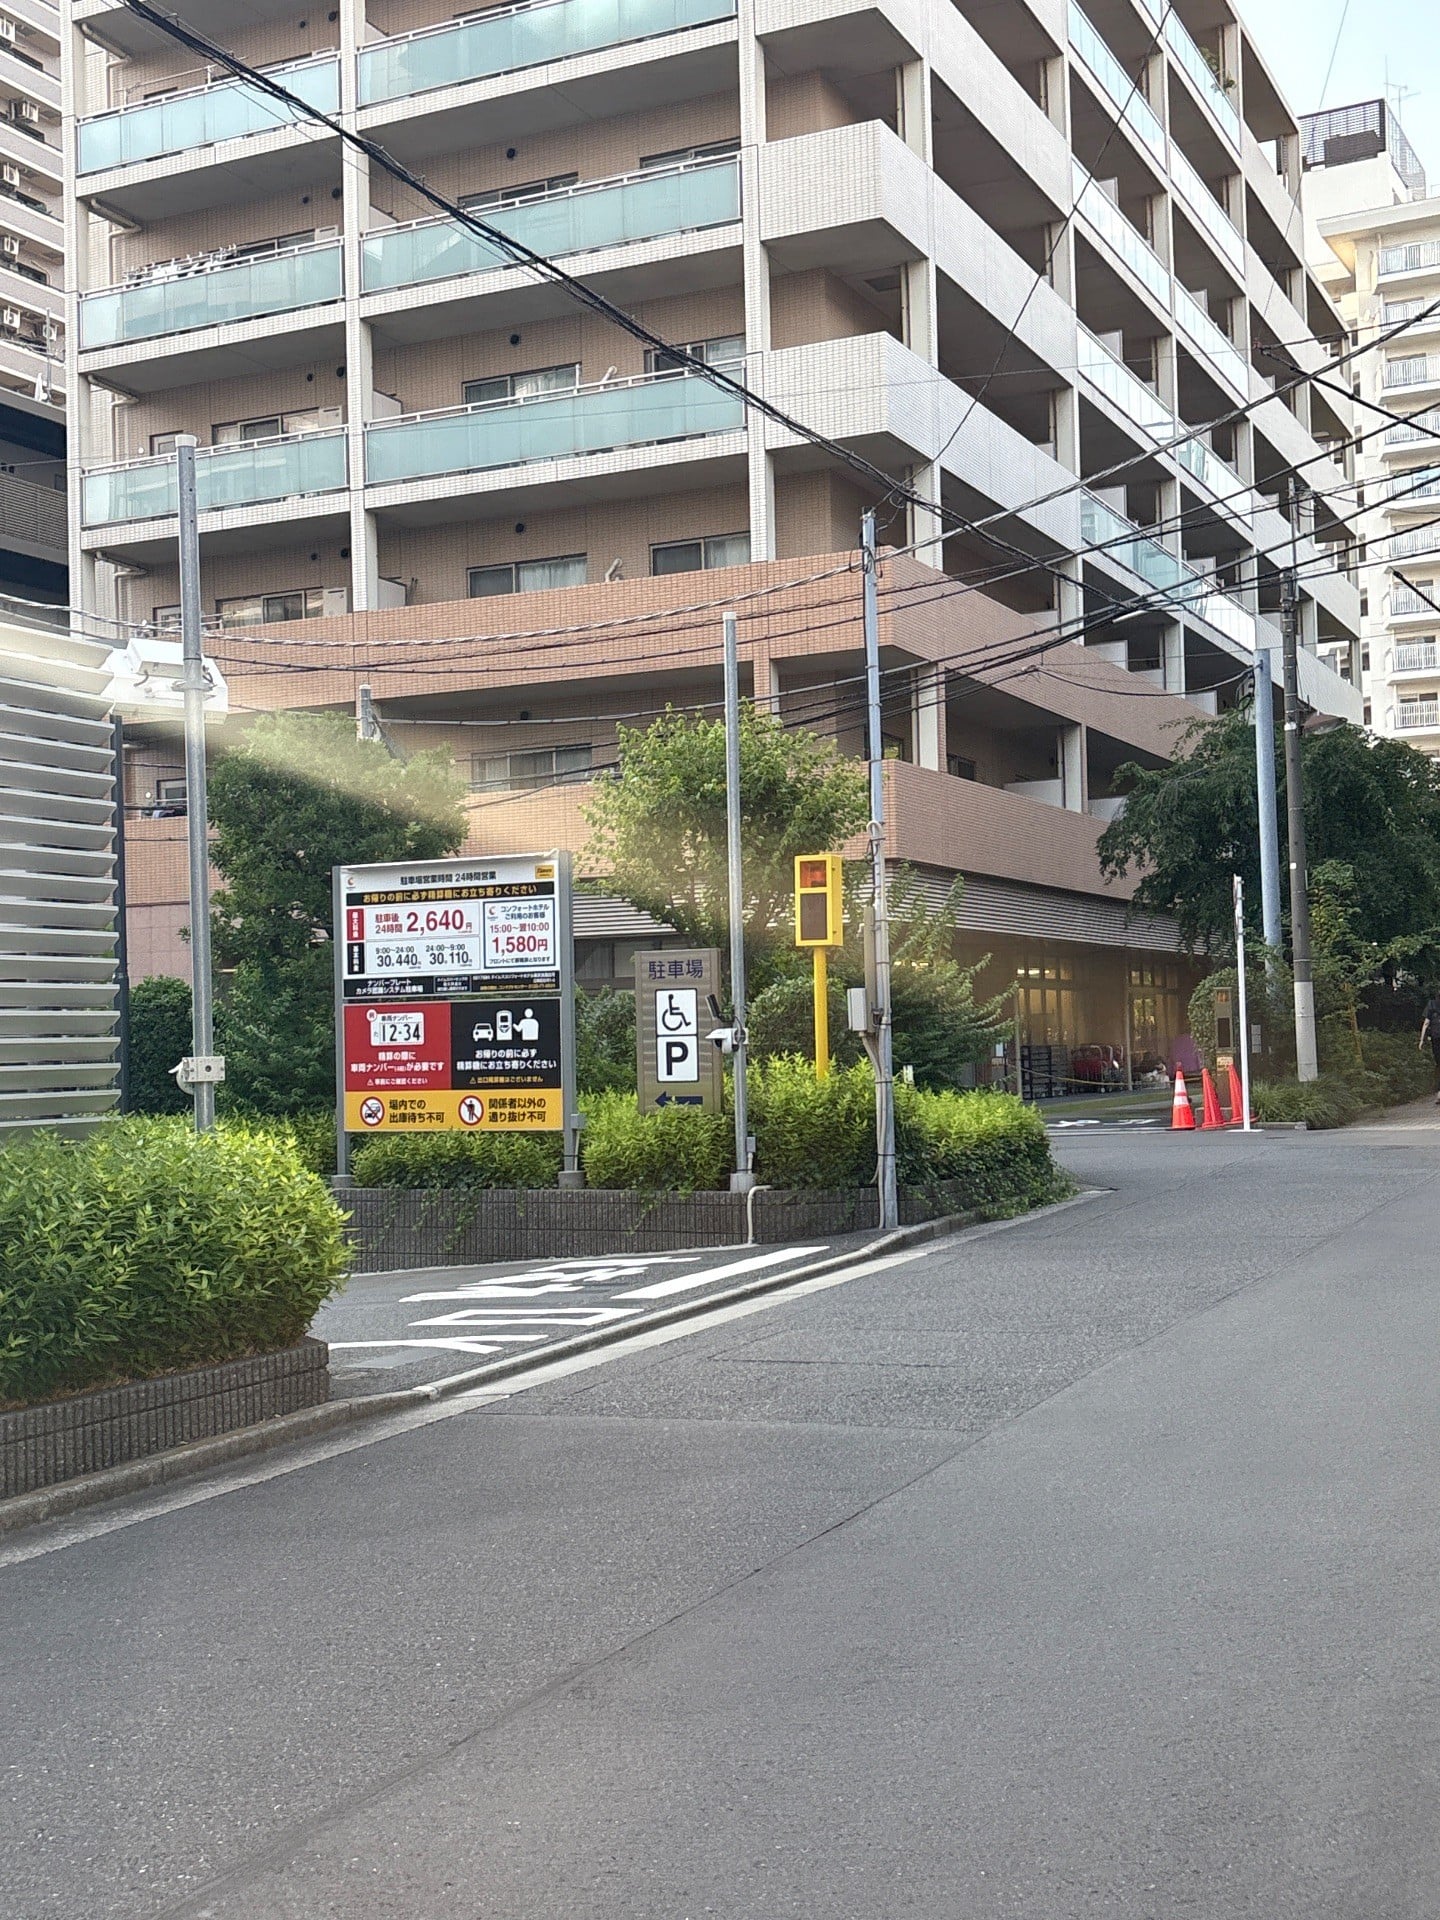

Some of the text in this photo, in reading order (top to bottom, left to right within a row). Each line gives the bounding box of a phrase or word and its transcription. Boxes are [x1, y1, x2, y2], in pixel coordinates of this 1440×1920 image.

[455, 871, 497, 883] 24時間営業
[501, 903, 550, 913] コンフォートホテル
[375, 913, 400, 924] 駐車後
[375, 923, 403, 935] 24時間
[492, 935, 548, 957] 1,580円
[648, 959, 704, 980] 駐車場
[367, 978, 412, 987] ナンバープレート
[474, 1049, 537, 1060] お帰りの前に必ず
[665, 1041, 689, 1076] P
[456, 1060, 557, 1071] 精算機にお立ち寄りください
[388, 1099, 426, 1111] 場内での
[488, 1097, 547, 1109] 関係者以外の
[388, 1111, 445, 1123] 出庫待ち不可
[488, 1110, 547, 1123] 通り抜け不可
